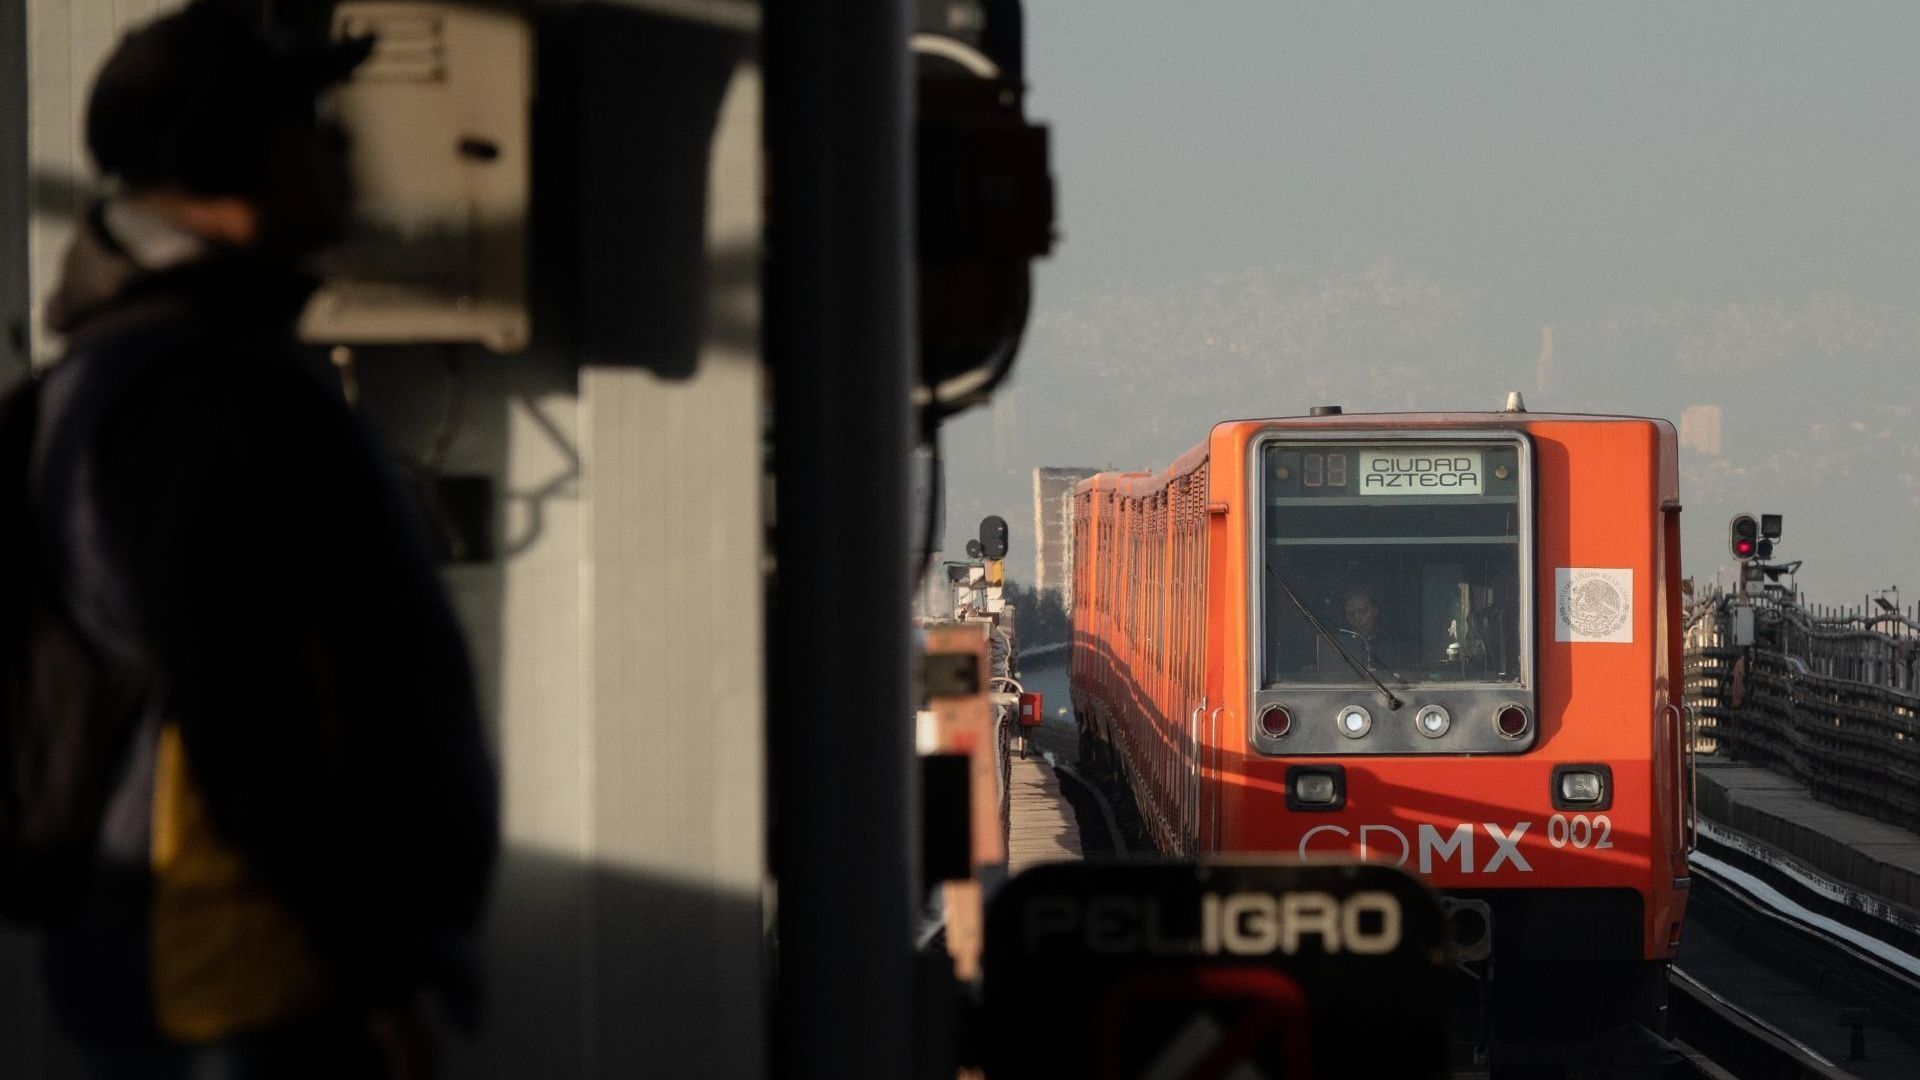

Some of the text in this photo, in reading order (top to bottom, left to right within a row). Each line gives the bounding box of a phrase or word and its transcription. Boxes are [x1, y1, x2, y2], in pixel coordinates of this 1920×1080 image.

[1365, 472, 1478, 488] AZTECA
[1371, 457, 1472, 472] CIUDAD
[1298, 821, 1534, 874] CDMX
[1547, 813, 1614, 850] 002
[1022, 891, 1402, 955] PELIGRO
